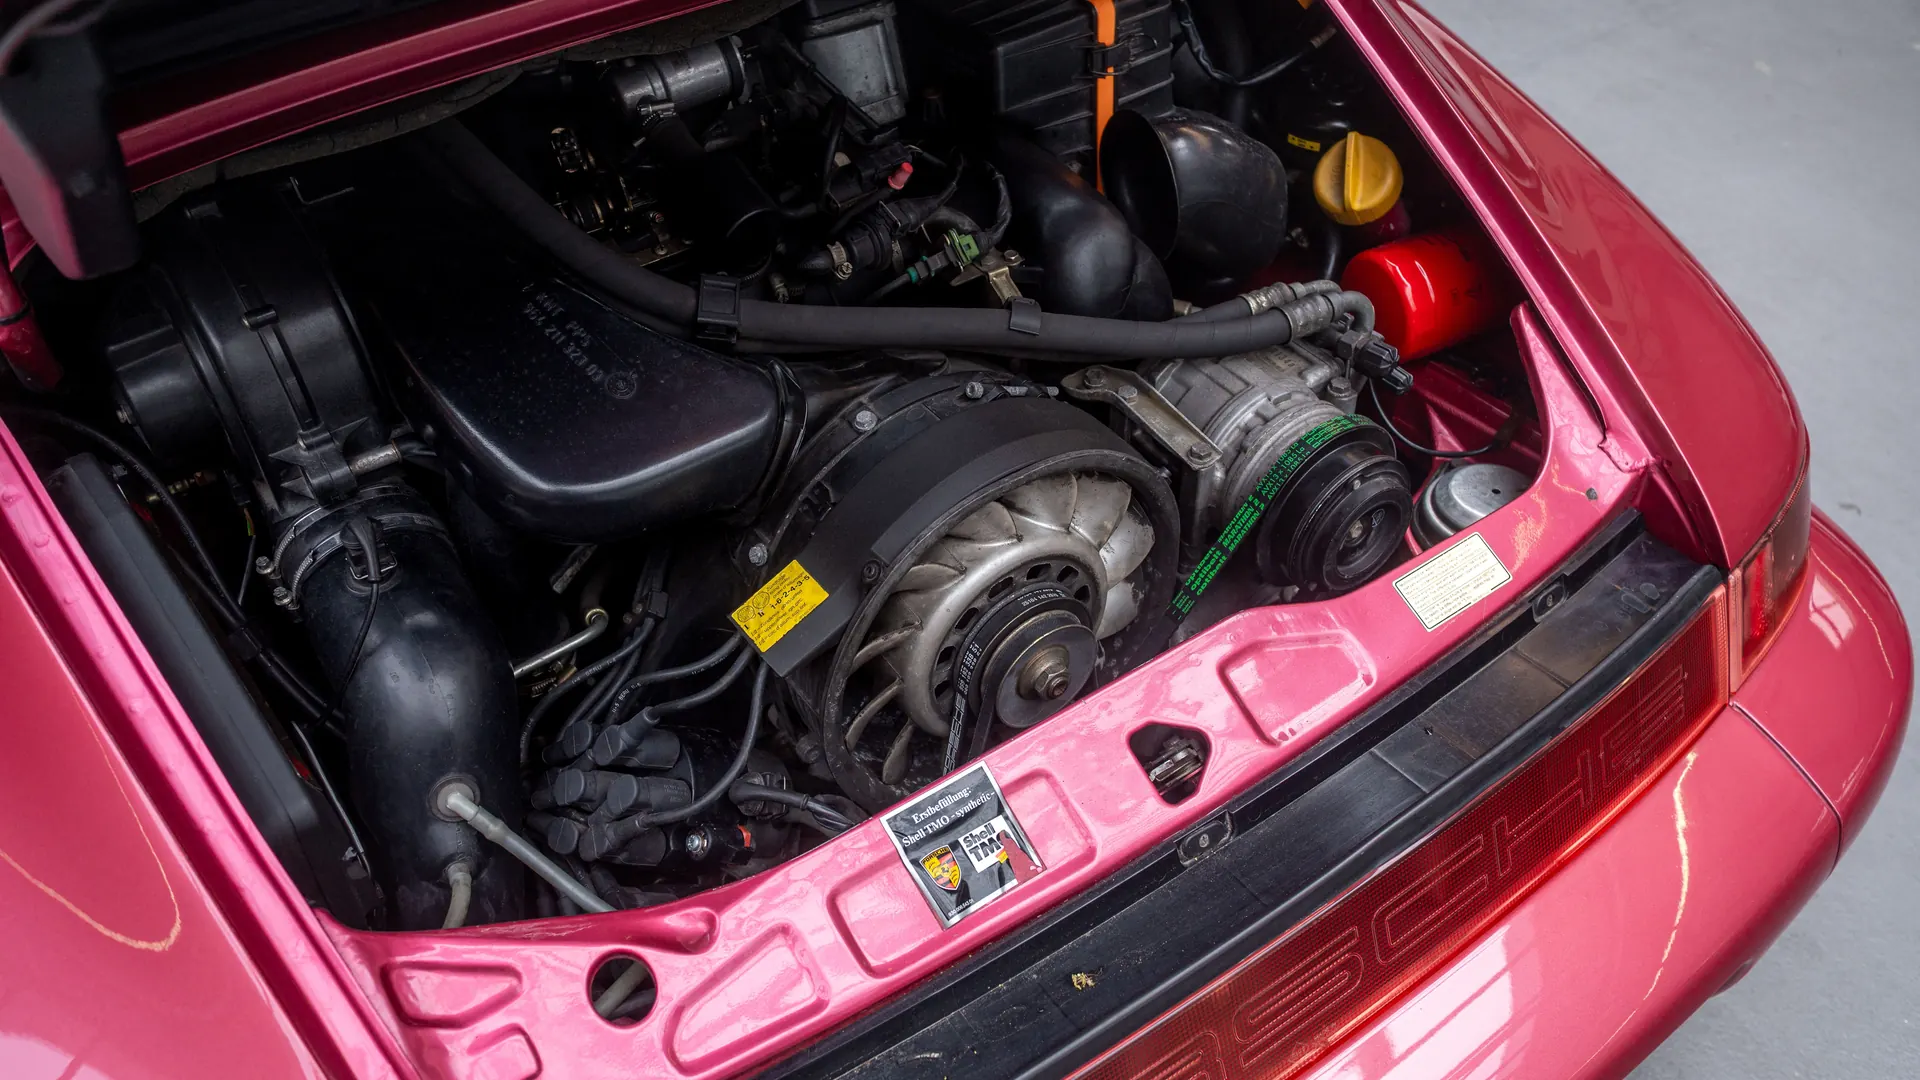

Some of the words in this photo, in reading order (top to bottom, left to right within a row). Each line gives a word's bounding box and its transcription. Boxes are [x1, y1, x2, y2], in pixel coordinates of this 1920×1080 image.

[1306, 420, 1351, 444] PORSCHE
[1261, 473, 1279, 496] AVX13
[1281, 453, 1298, 469] 1085
[1222, 505, 1254, 547] MARATHON
[1253, 498, 1259, 506] 2
[1228, 510, 1260, 552] MARATHON
[1190, 550, 1221, 591] optibelt
[1196, 555, 1227, 595] optibelt
[770, 575, 810, 610] 1-6-2-4-3-5
[618, 688, 630, 701] BERU
[911, 786, 972, 824] Erstbefüllung:
[962, 822, 996, 848] Shell
